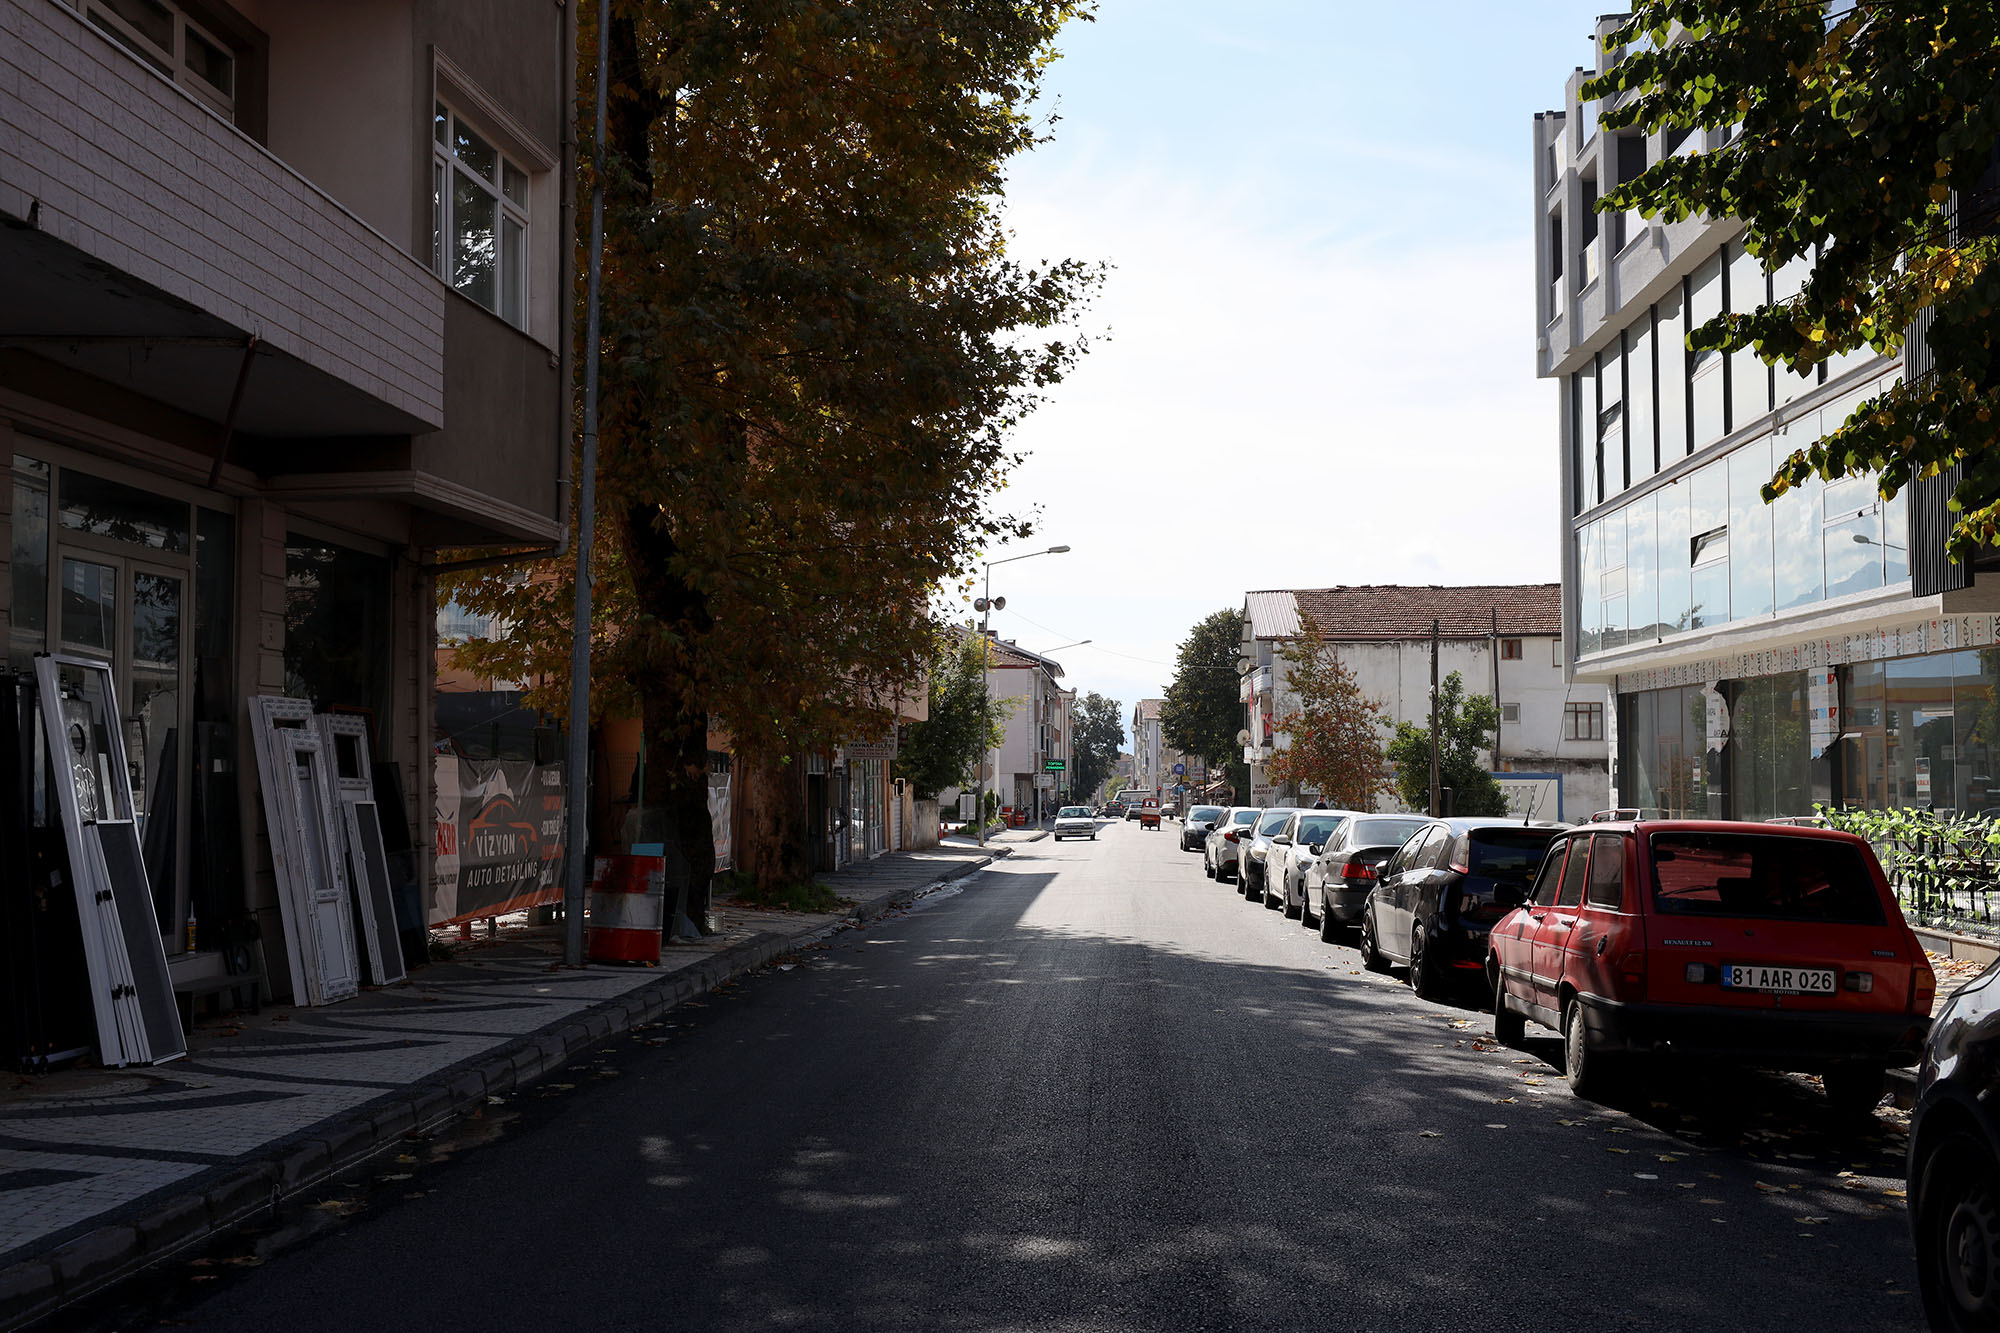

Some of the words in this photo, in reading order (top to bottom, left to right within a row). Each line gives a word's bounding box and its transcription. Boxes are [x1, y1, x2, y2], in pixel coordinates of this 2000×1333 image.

[476, 829, 516, 857] VİZYON
[467, 867, 493, 888] AUTO
[1733, 967, 1753, 986] 81
[1760, 969, 1793, 988] AAR
[1799, 972, 1832, 990] 026
